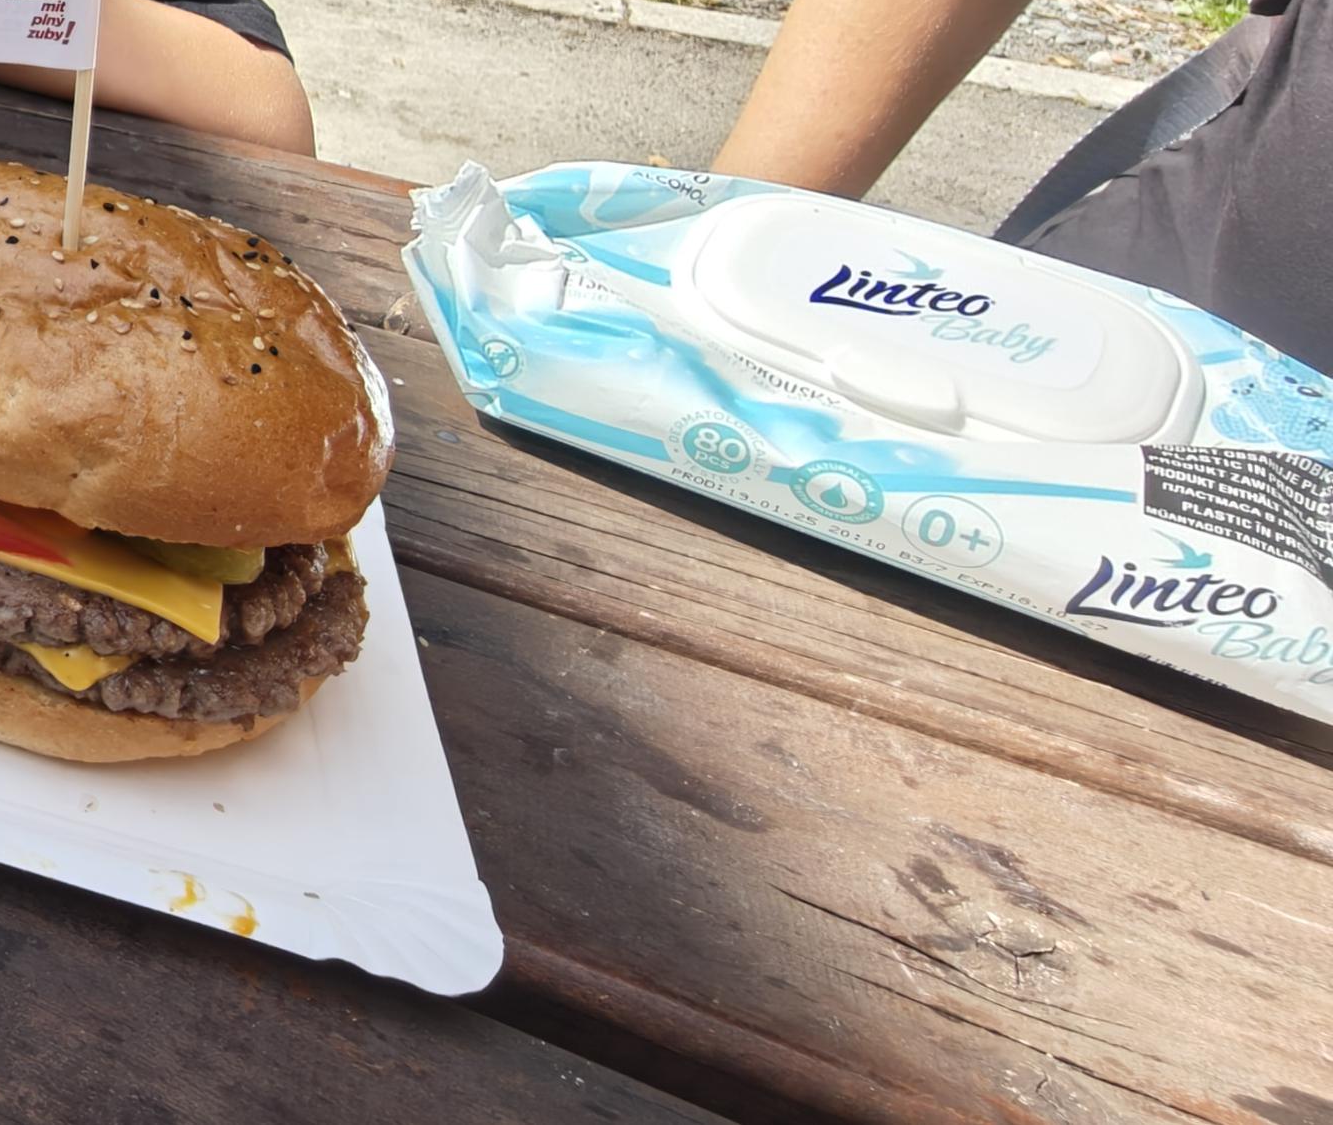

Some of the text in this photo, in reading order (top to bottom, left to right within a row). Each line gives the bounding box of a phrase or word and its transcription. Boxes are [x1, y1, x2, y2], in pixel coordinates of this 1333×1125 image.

[30, 14, 65, 28] plný
[632, 171, 707, 207] ALCOHOL
[809, 264, 991, 316] Linteo
[919, 315, 1059, 364] Baby
[693, 427, 747, 464] 80
[694, 450, 732, 471] pcs
[1145, 463, 1216, 490] PRODUKT
[1217, 482, 1281, 513] ENTHÄLT
[1161, 450, 1333, 516] PLASTIC IN PRODUC
[917, 509, 991, 552] 0+
[1181, 500, 1253, 530] PLASTIC
[828, 525, 887, 552] 20:10
[899, 550, 948, 573] B3/7
[1065, 554, 1280, 627] Linteo
